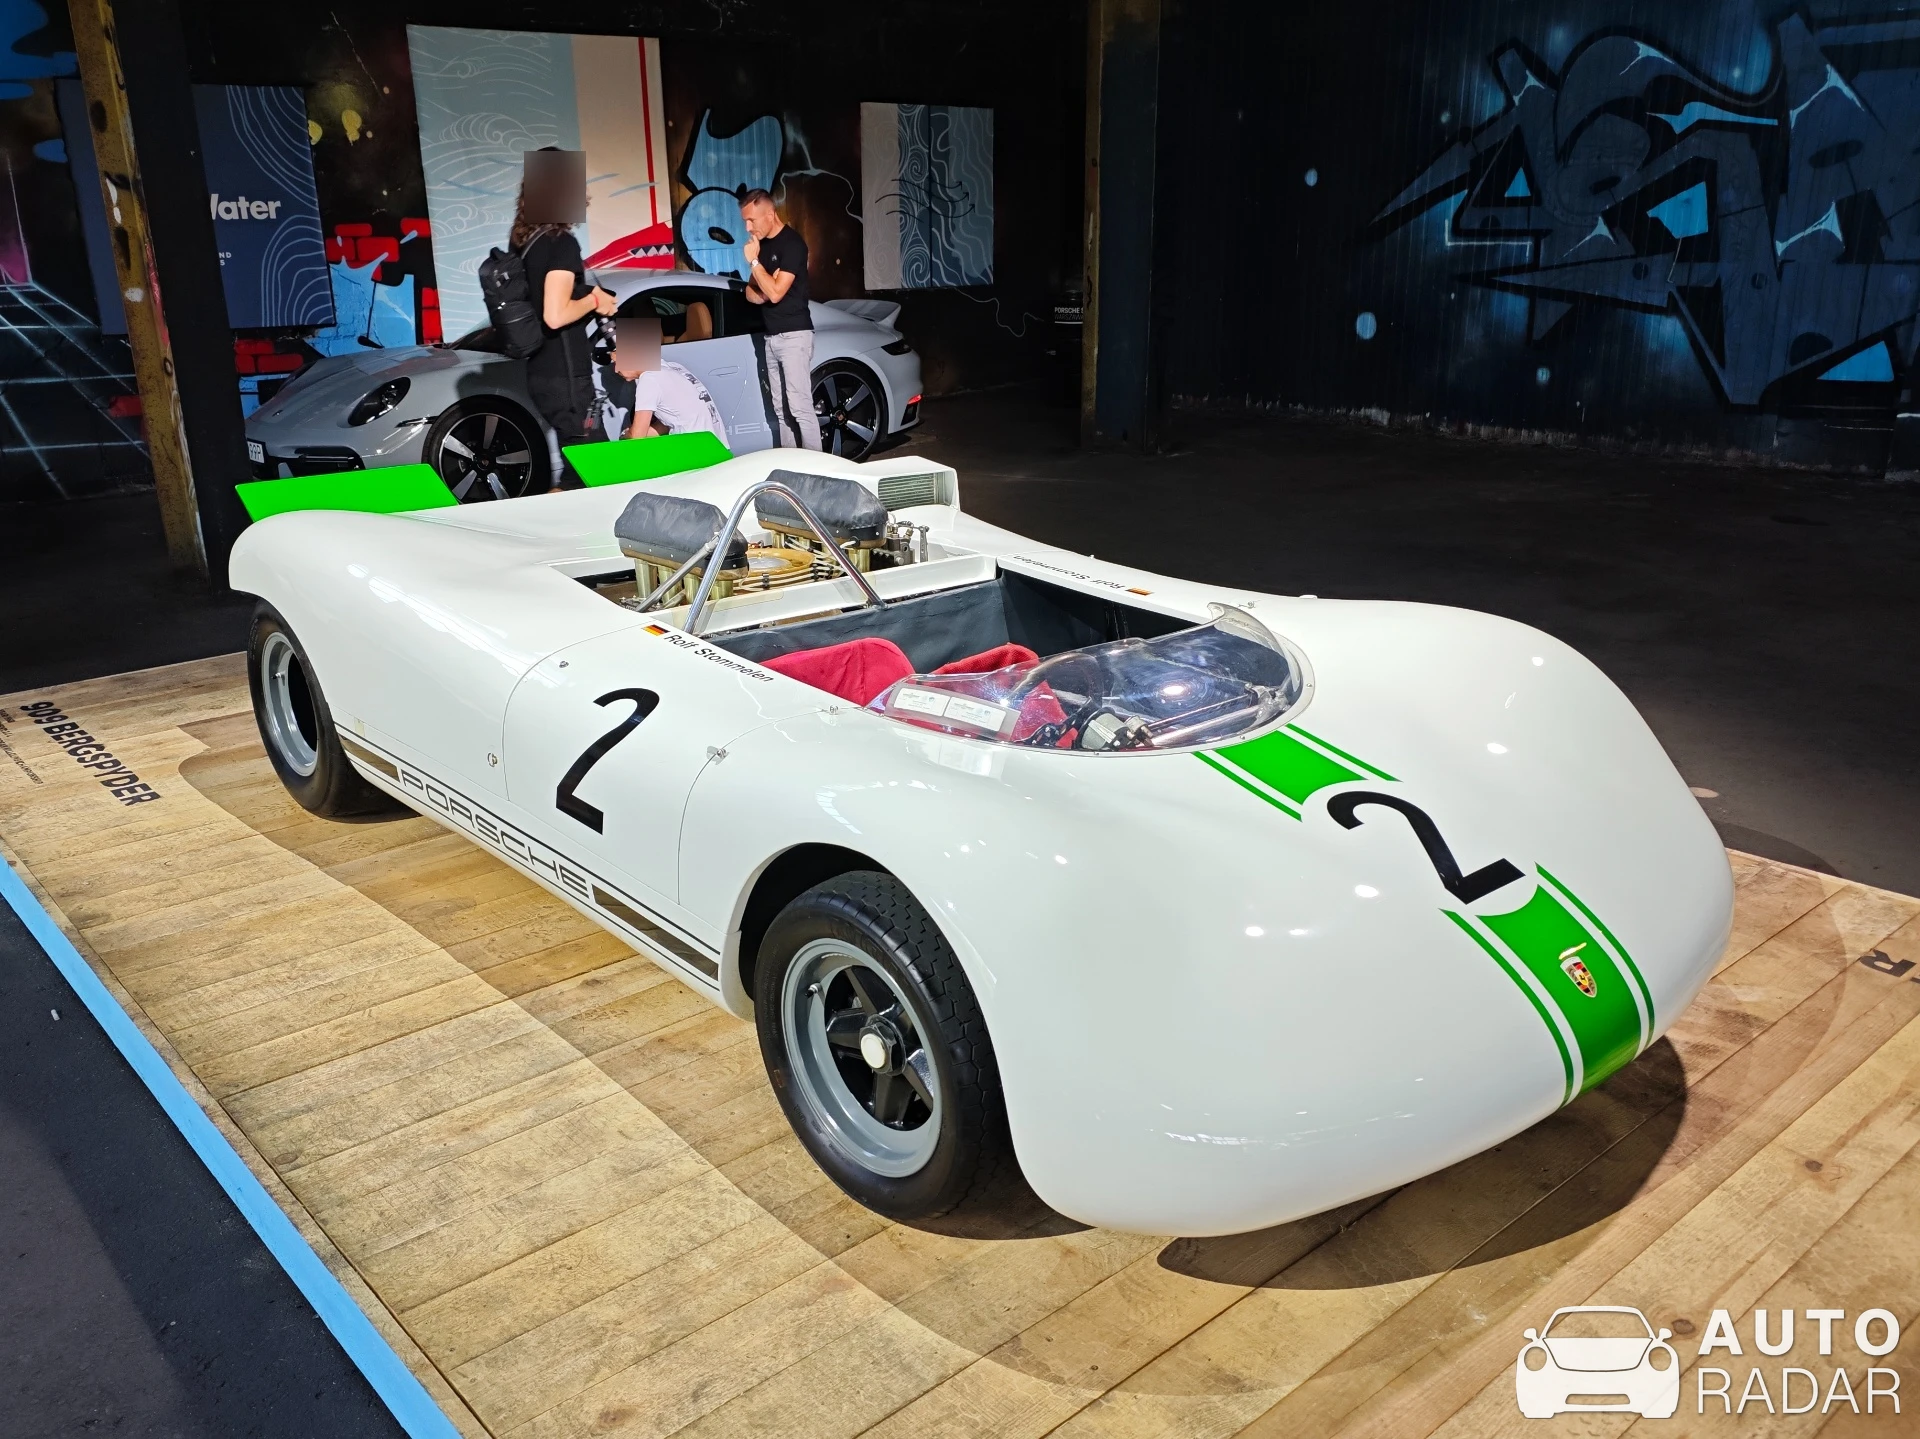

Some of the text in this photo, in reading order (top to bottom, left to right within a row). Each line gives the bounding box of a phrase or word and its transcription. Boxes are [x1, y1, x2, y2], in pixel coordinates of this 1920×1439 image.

[210, 193, 281, 220] ater
[663, 633, 775, 683] Rolf Stommelen
[19, 701, 70, 725] 909
[42, 721, 162, 807] BERGSPYDER
[556, 687, 660, 835] 2
[400, 768, 590, 900] PORSCHE
[1326, 790, 1526, 905] 2
[1859, 948, 1920, 985] R
